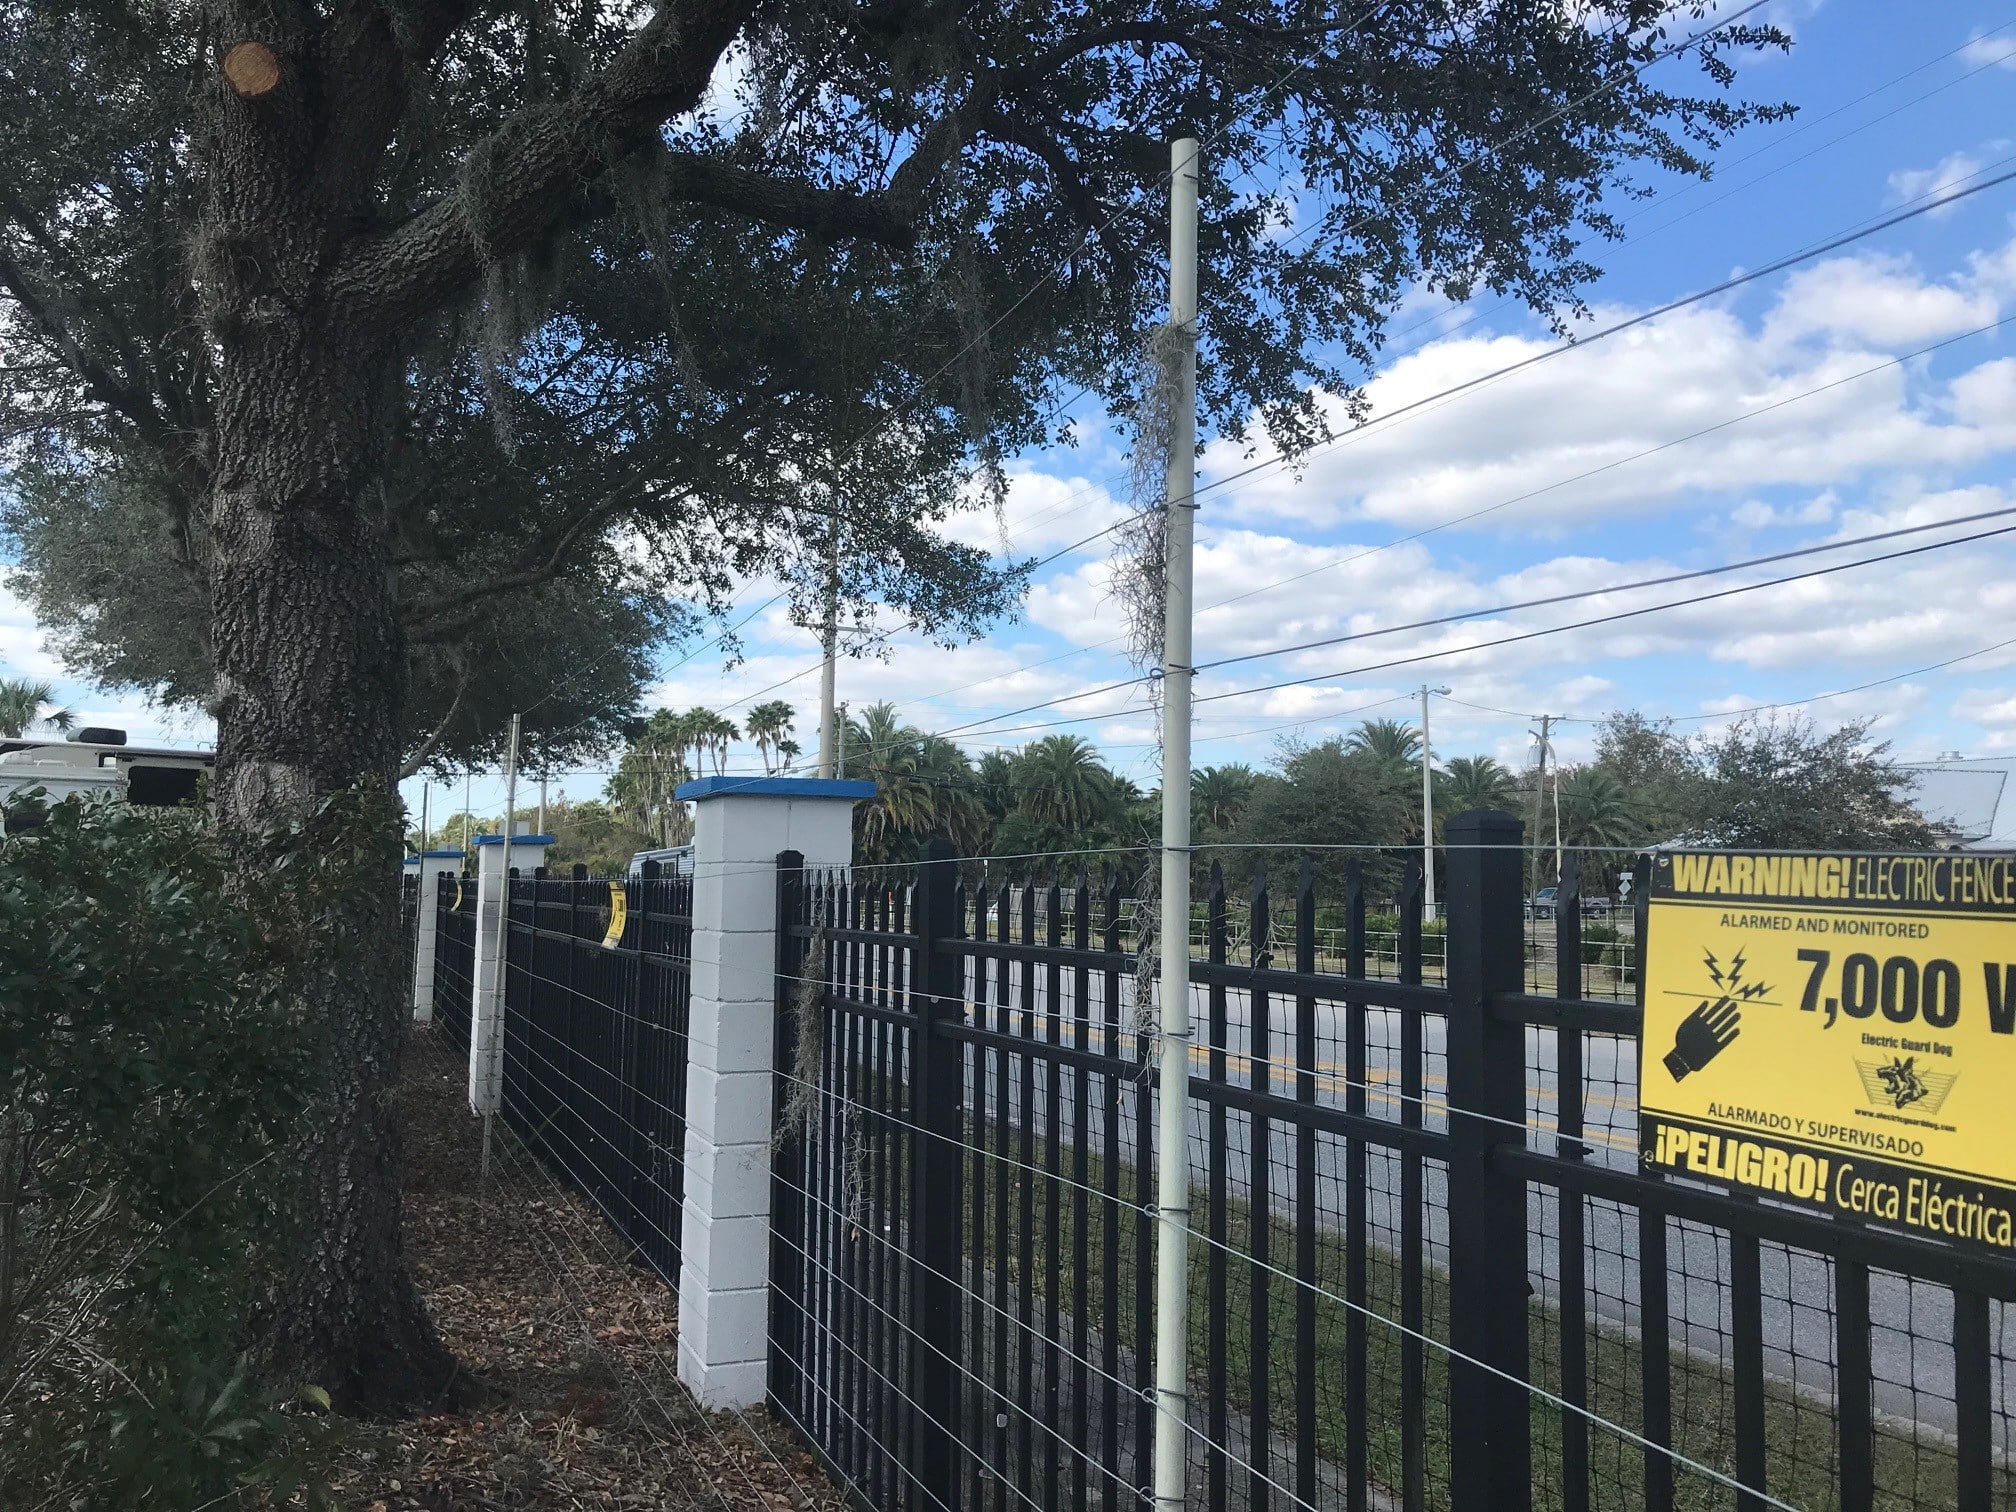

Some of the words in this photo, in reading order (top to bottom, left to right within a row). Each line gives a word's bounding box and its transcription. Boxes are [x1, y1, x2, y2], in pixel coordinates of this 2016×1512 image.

[1672, 854, 1850, 899] WARNING!
[1855, 857, 1946, 902] ELECTRIC
[1951, 858, 2015, 904] FENCE
[1720, 913, 1792, 931] ALARMED
[1795, 917, 1829, 933] AND
[1833, 919, 1930, 939] MONITORED
[1797, 948, 1960, 1030] 7,000
[1861, 1032, 1899, 1048] Electric
[1901, 1037, 1931, 1053] Guard
[1933, 1041, 1953, 1057] Dog
[1708, 1102, 1791, 1131] ALARMADO
[1795, 1117, 1805, 1133] Y
[1808, 1121, 1924, 1157] SUPERVISADO
[1655, 1124, 1829, 1202] ¡PELIGRO!
[1835, 1163, 1900, 1220] Cerca
[1905, 1177, 2012, 1246] Eléctrica
